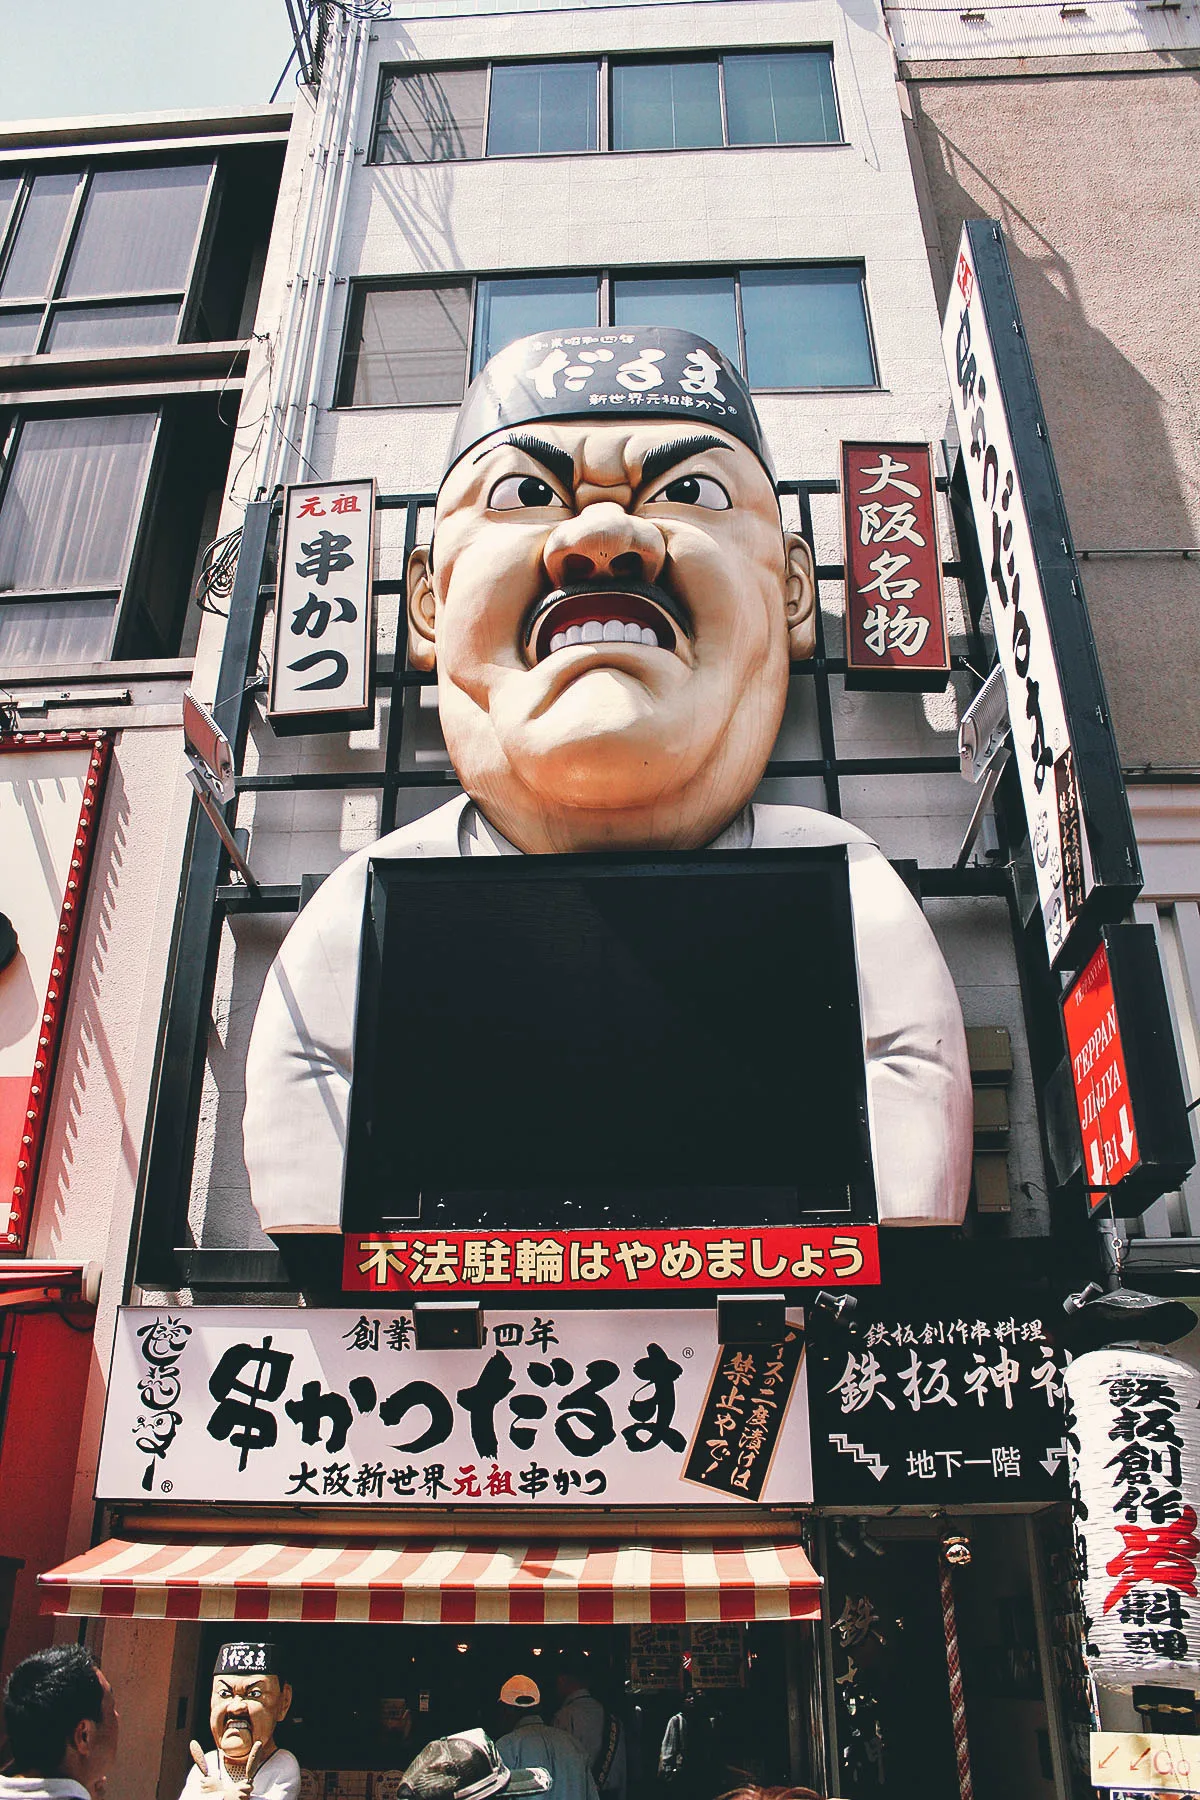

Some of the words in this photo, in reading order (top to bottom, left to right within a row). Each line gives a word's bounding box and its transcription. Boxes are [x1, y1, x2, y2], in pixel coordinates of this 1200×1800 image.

[526, 348, 726, 403] だるま
[588, 392, 727, 415] 新世界元祖串かつ
[296, 494, 362, 519] 元祖
[857, 454, 931, 656] 大阪名物
[286, 530, 358, 691] 串かつ
[1074, 1004, 1117, 1085] TEPPAN
[1082, 1059, 1122, 1130] JINJYA
[1103, 1133, 1120, 1174] B1
[357, 1236, 865, 1285] 不法駐輪はやめましょう
[342, 1315, 560, 1353] 創業四年
[863, 1317, 1047, 1347] 鉄板創作串料理
[207, 1336, 688, 1474] 串かつだるま
[285, 1462, 608, 1500] 大阪新世界元祖串かつ
[906, 1447, 1021, 1479] 地下一階
